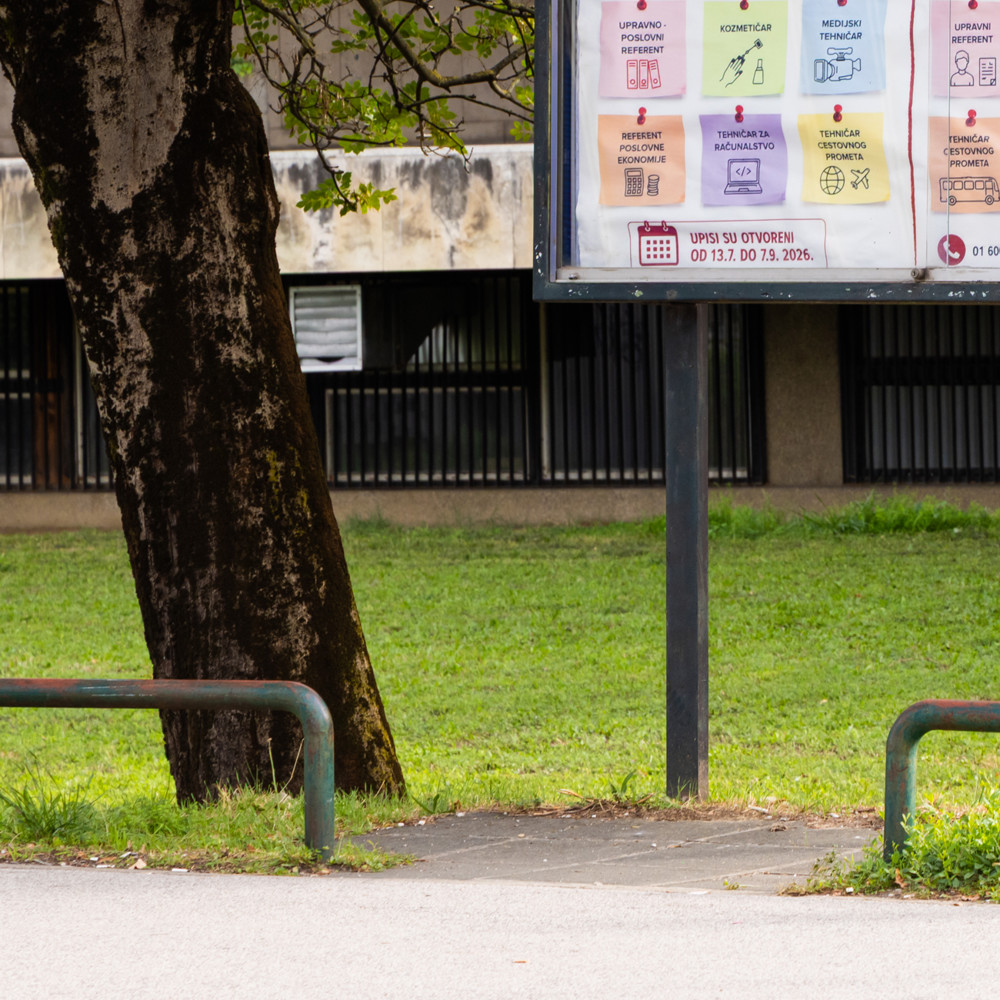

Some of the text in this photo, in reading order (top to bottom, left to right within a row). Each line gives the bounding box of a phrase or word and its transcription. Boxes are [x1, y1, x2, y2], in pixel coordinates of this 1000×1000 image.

[619, 20, 662, 30] UPRAVNO
[720, 22, 772, 32] KOZMETIČAR
[822, 20, 862, 28] MEDIJSKI
[954, 22, 992, 31] UPRAVNI
[621, 34, 664, 42] POSLOVNI
[820, 31, 862, 40] TEHNIČAR
[952, 35, 994, 44] REFERENT
[621, 46, 664, 54] REFERENT
[622, 132, 662, 140] REFERENT
[717, 129, 757, 138] TEHNIČAR
[819, 128, 860, 138] TEHNIČAR
[949, 134, 990, 143] TEHNIČAR
[620, 144, 665, 152] POSLOVNE
[714, 142, 774, 152] RAČUNALSTVO
[818, 142, 867, 150] CESTOVNOG
[944, 146, 994, 155] CESTOVNOG
[618, 156, 666, 164] EKONOMIJE
[950, 160, 990, 168] PROMETA
[690, 232, 794, 244] UPISI SU OTVORENI
[691, 248, 814, 262] OD 13.7. DO 7.9. 2026.
[972, 246, 984, 256] 01
